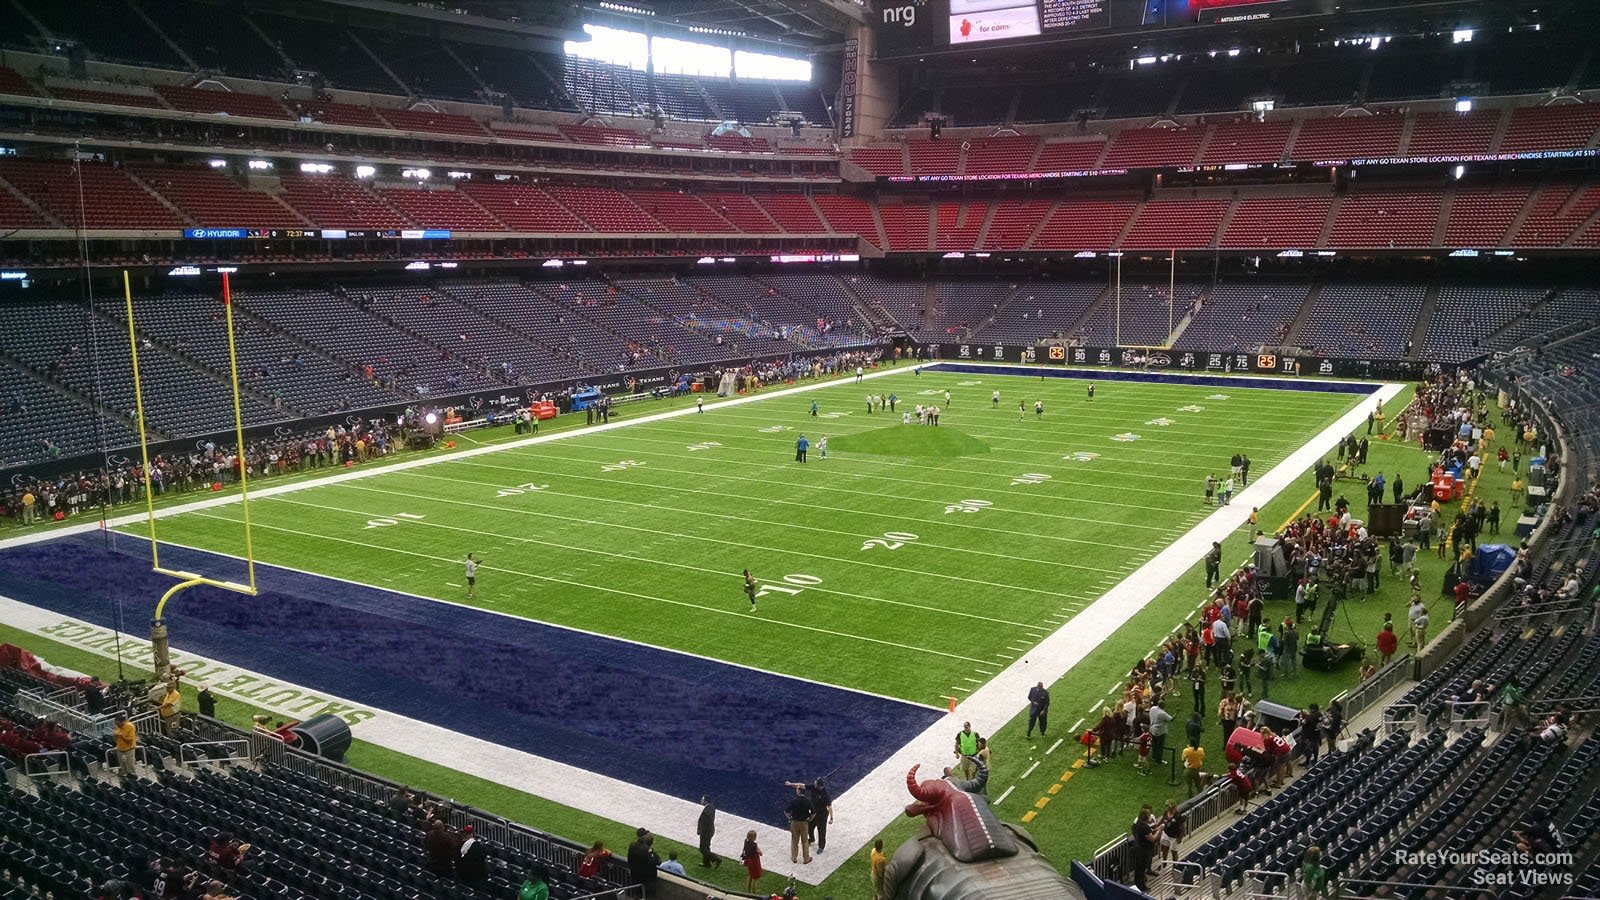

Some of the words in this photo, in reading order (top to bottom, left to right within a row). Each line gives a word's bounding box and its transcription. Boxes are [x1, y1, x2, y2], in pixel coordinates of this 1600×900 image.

[883, 6, 915, 26] nrg
[1100, 353, 1110, 361] 99
[1210, 358, 1220, 366] 25
[1260, 356, 1273, 366] 25
[1236, 358, 1248, 367] 75
[1284, 362, 1292, 370] 17
[1320, 363, 1332, 372] 29
[489, 397, 520, 405] TEANS
[946, 500, 994, 513] 30
[862, 532, 920, 550] 20
[760, 574, 823, 596] 10
[213, 675, 376, 726] SALUTE
[153, 878, 166, 896] 99
